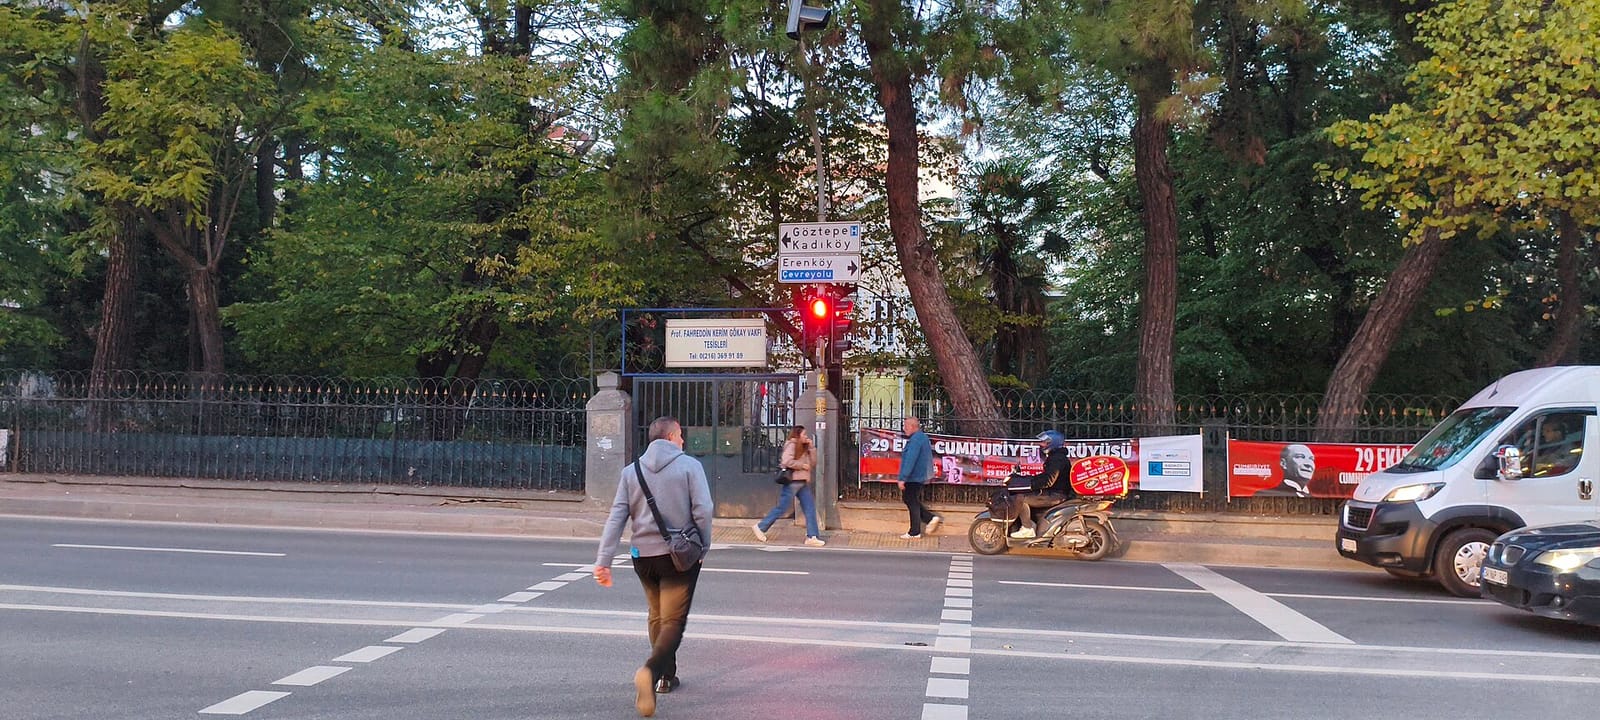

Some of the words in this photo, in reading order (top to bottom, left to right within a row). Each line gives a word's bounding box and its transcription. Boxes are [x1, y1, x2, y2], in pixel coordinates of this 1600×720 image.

[792, 227, 848, 238] Göztepe
[792, 240, 850, 250] Kadıköy
[783, 258, 833, 268] Erenköy
[683, 328, 712, 337] FAHREDDİN
[712, 328, 728, 337] KERİM
[729, 328, 746, 337] GÖKAY
[747, 328, 762, 337] VAKFI
[704, 339, 728, 349] TESİSLERİ
[870, 439, 889, 452] 29
[934, 440, 1040, 457] CUMHURİYET
[1355, 447, 1374, 471] 29
